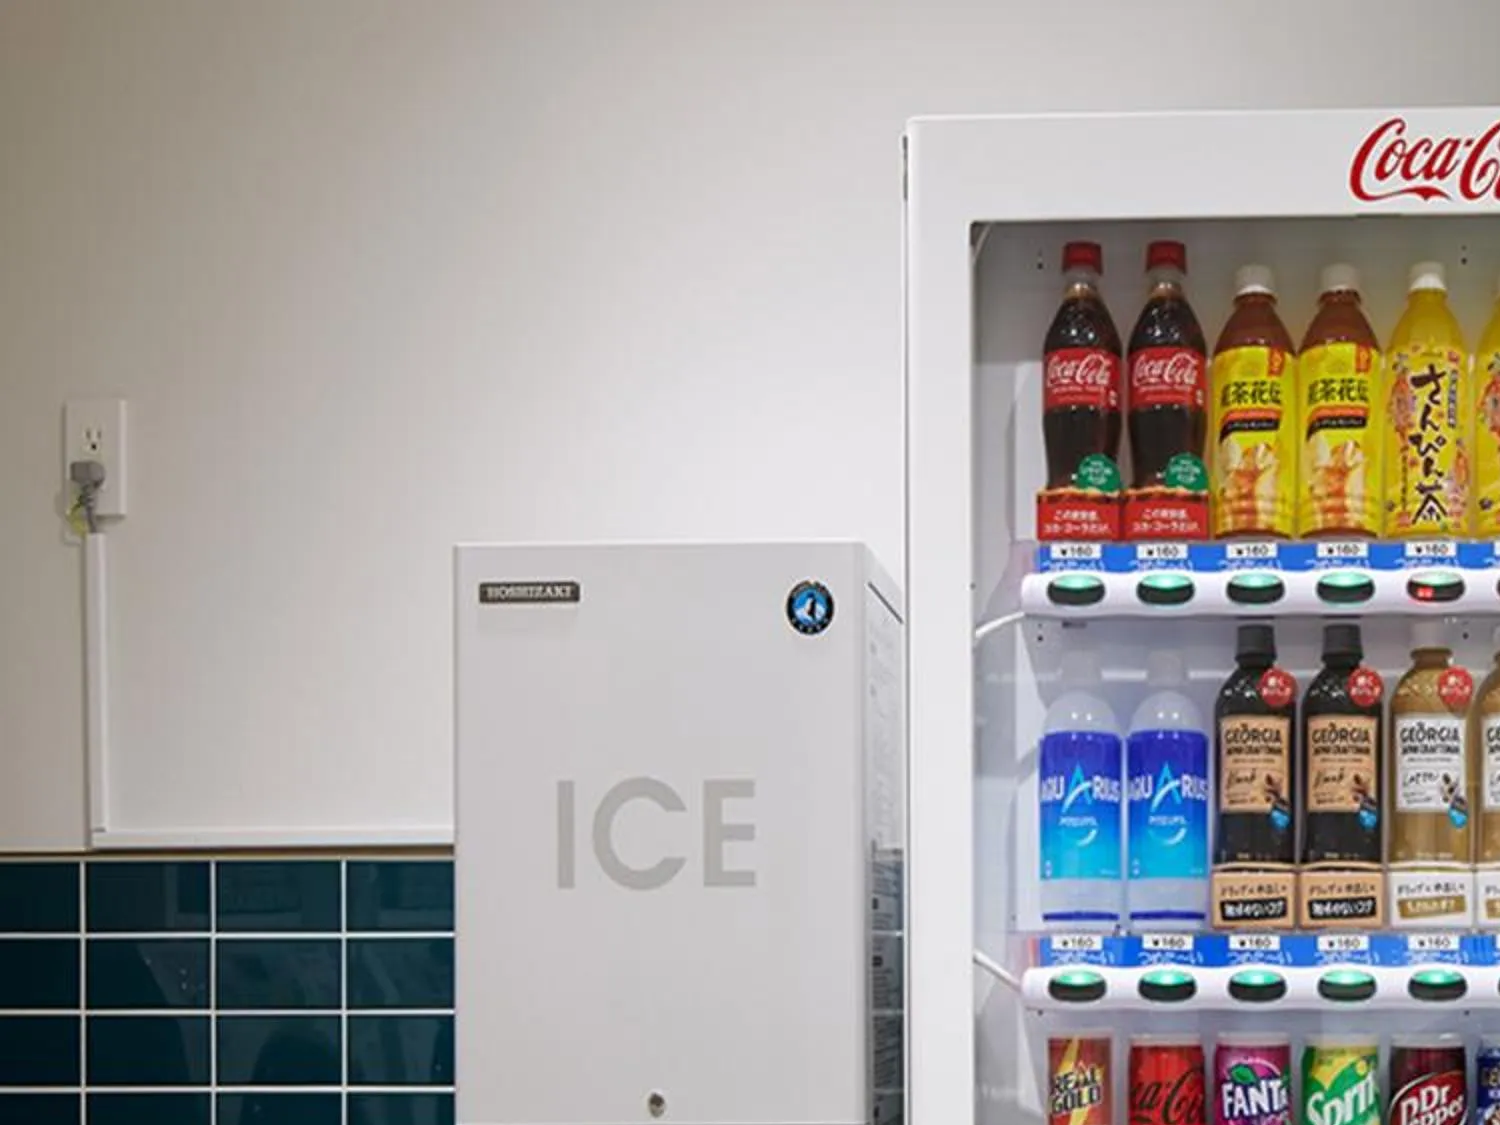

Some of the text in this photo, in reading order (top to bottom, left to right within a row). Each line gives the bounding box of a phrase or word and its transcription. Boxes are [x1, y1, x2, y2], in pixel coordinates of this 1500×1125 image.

[1409, 363, 1448, 525] さんぴん茶
[1225, 722, 1282, 744] GEORGIA
[1312, 721, 1371, 744] GEORGIA
[1401, 720, 1460, 743] GEORGIA
[556, 776, 757, 891] ICE
[1421, 1085, 1451, 1111] Dr
